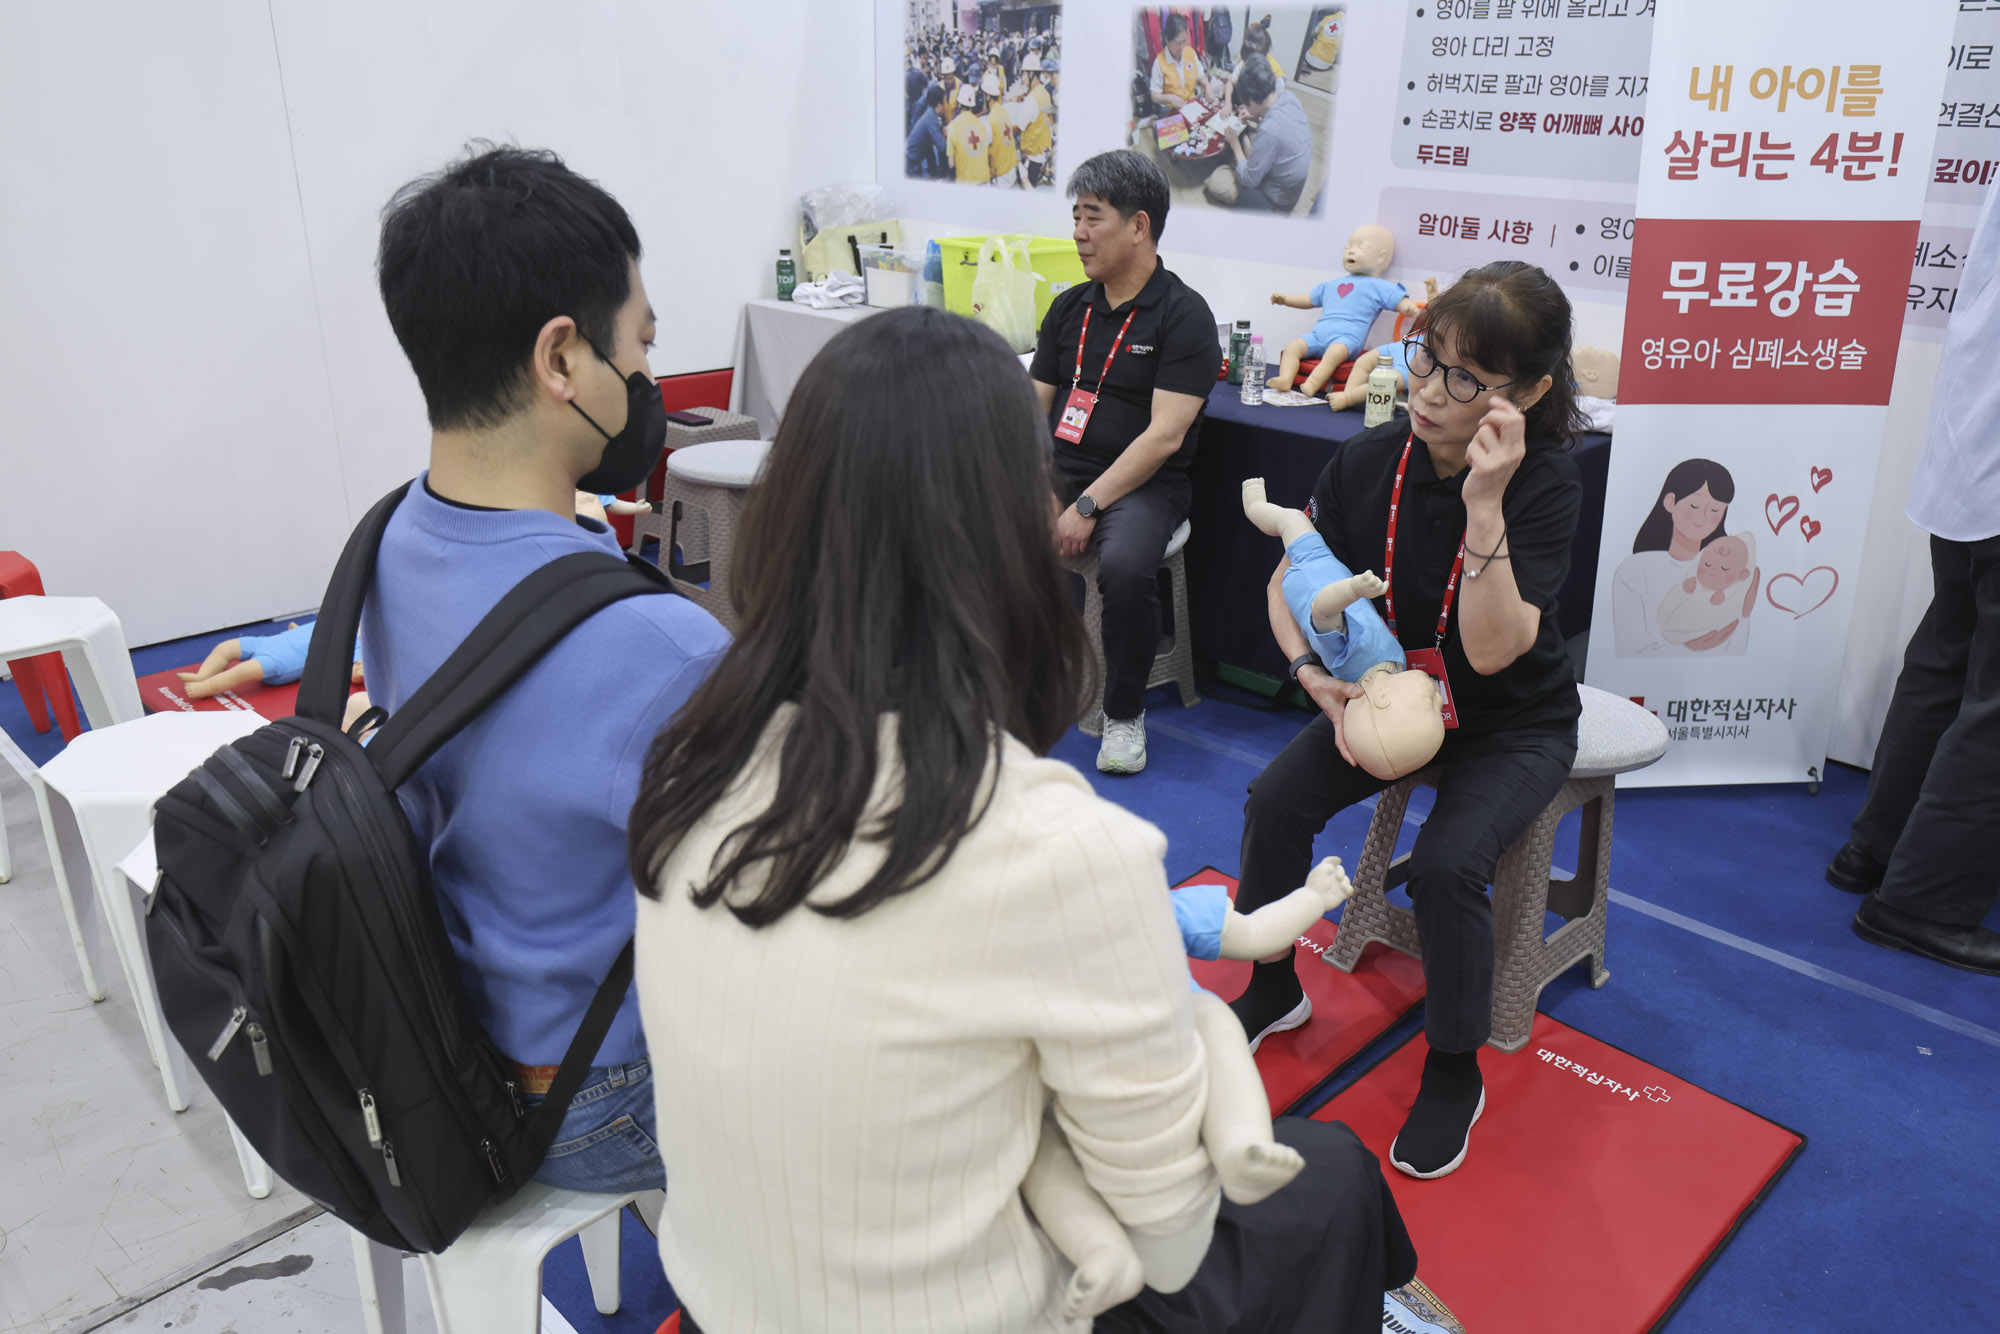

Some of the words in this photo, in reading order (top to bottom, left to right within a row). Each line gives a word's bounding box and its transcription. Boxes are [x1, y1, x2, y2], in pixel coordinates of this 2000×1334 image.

[1431, 36, 1467, 57] 영아
[1472, 36, 1509, 57] 다리
[1514, 36, 1554, 57] 고정
[1426, 73, 1498, 94] 허벅지로
[1504, 74, 1543, 95] 팔과
[1550, 75, 1609, 97] 영아를
[1688, 65, 1734, 112] 내
[1749, 65, 1884, 117] 아이를
[1421, 109, 1493, 131] 손꿈치로
[1499, 111, 1537, 133] 양쪽
[1543, 113, 1603, 136] 어깨뼈
[1416, 144, 1470, 167] 두드림
[1664, 130, 1795, 181] 살리는
[1810, 132, 1905, 181] 4분!
[1418, 213, 1481, 240] 알아둘
[1487, 220, 1533, 245] 사항
[1662, 258, 1861, 318] 무료강습
[1641, 337, 1721, 370] 영유아
[1729, 338, 1868, 371] 심폐소생술
[1667, 698, 1798, 722] 대한적십자사
[1536, 1048, 1641, 1102] 대한적십자사
